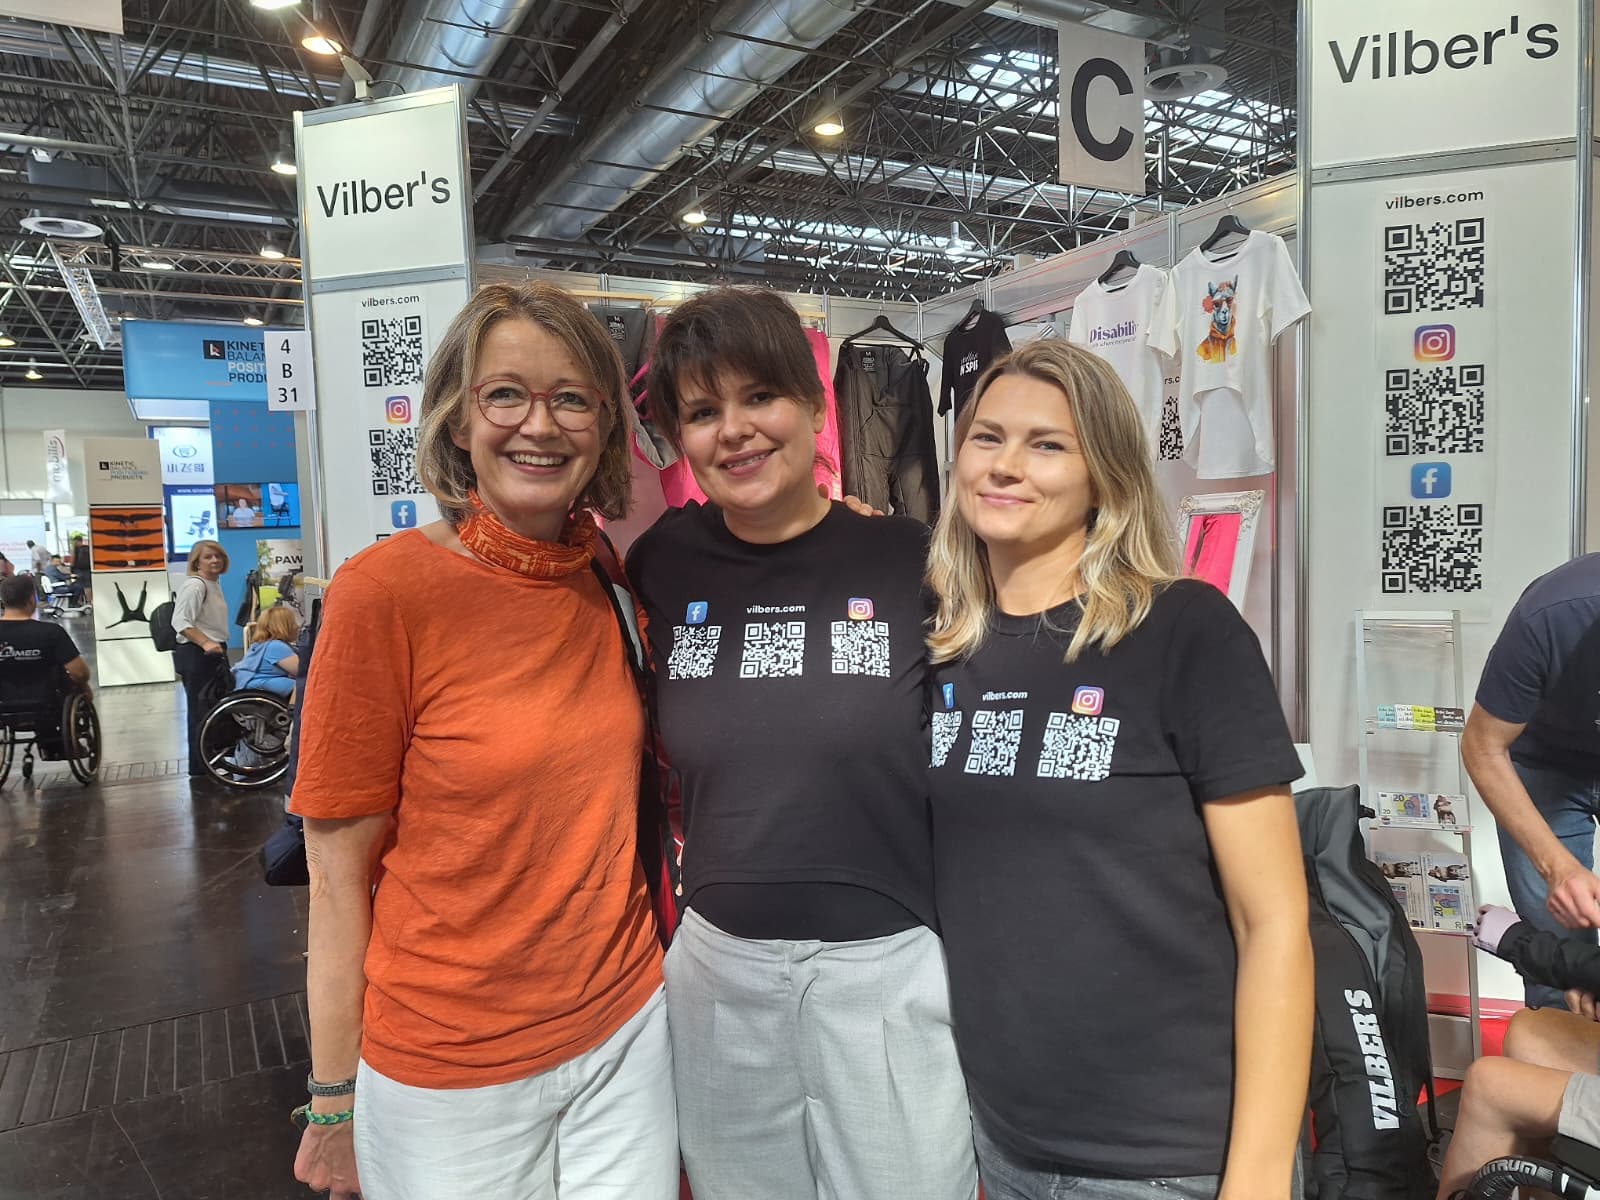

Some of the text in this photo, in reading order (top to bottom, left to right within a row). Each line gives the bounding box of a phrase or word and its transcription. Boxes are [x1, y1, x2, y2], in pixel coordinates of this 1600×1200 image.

[1328, 15, 1560, 84] Vilber's
[1070, 57, 1134, 162] C
[316, 170, 451, 218] Vilber's
[1385, 191, 1484, 210] vilbers.com
[361, 294, 420, 308] vilbers.com
[280, 338, 291, 354] 4
[282, 363, 293, 378] B
[278, 387, 298, 403] 31
[746, 604, 806, 614] vilbers.com
[982, 690, 1028, 702] vilbers.com
[1344, 989, 1400, 1130] VILBER'S
